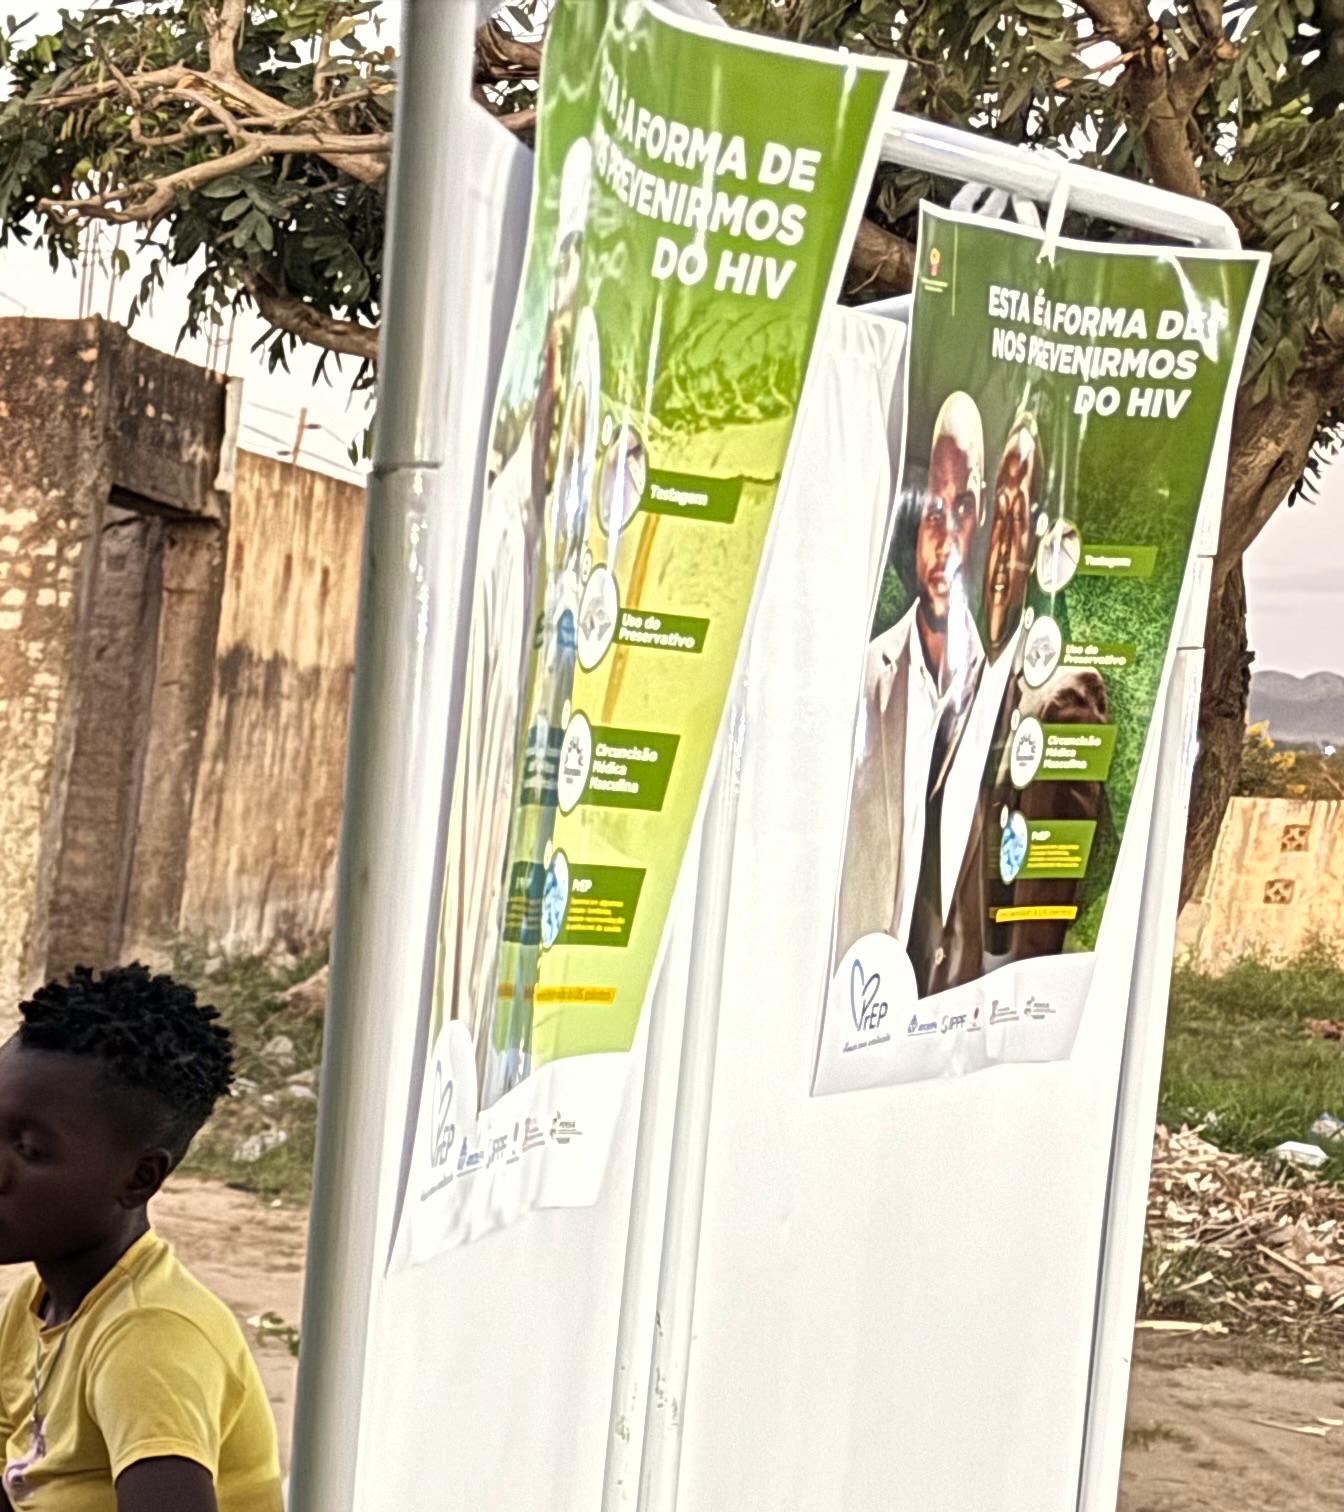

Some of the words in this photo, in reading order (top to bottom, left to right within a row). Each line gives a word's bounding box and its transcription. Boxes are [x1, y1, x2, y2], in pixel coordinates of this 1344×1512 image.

[635, 106, 747, 180] FORMA
[758, 141, 823, 193] DE
[606, 143, 808, 247] PREVENIRMOS
[651, 236, 708, 286] DO
[714, 249, 797, 300] HIV
[988, 284, 1030, 326] ESTA
[1049, 303, 1148, 341] FORMA
[1156, 308, 1208, 342] DE
[991, 327, 1027, 364] NOS
[1028, 337, 1200, 381] PREVENIRMOS
[1073, 385, 1121, 417] DO
[1126, 387, 1192, 419] HIV
[650, 485, 708, 507] Testagem
[618, 626, 695, 650] Preservativo
